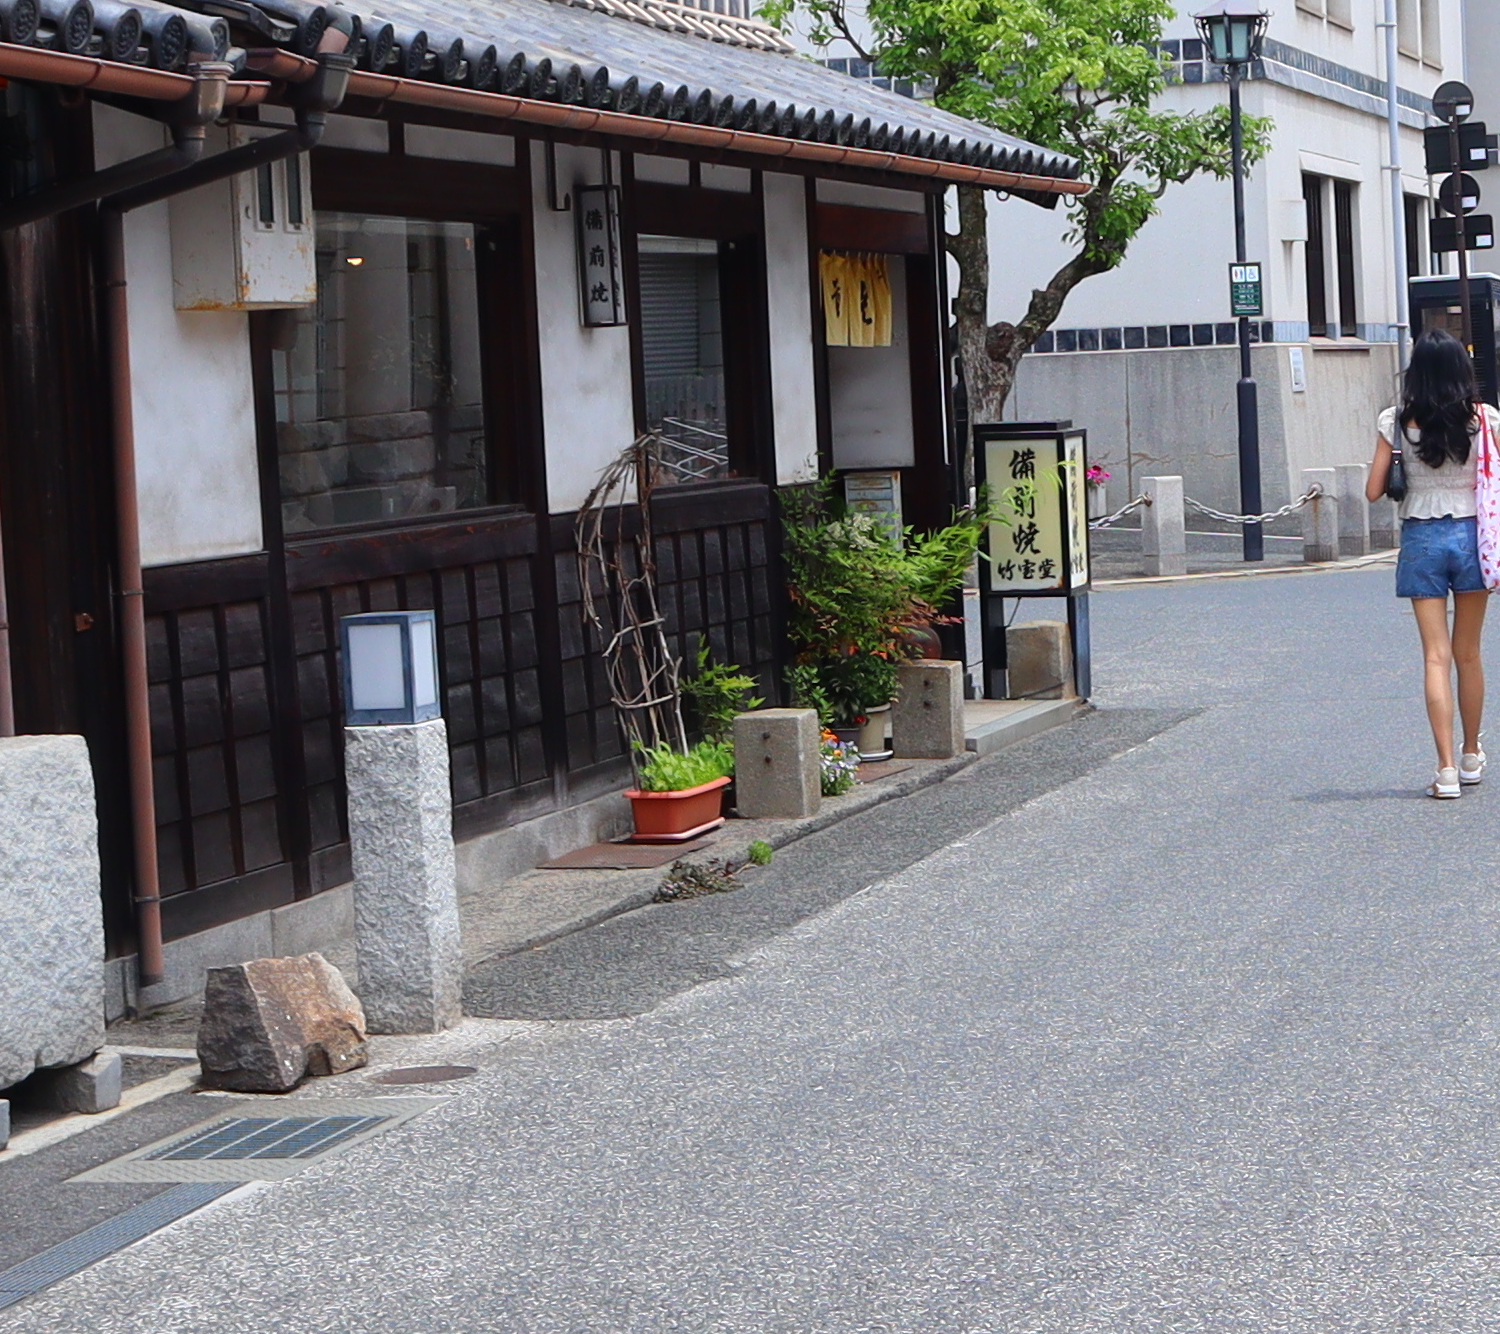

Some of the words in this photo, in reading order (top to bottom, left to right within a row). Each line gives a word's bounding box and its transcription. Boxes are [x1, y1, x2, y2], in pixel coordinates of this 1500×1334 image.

[585, 208, 609, 304] 備前焼
[1009, 447, 1041, 555] 備前焼
